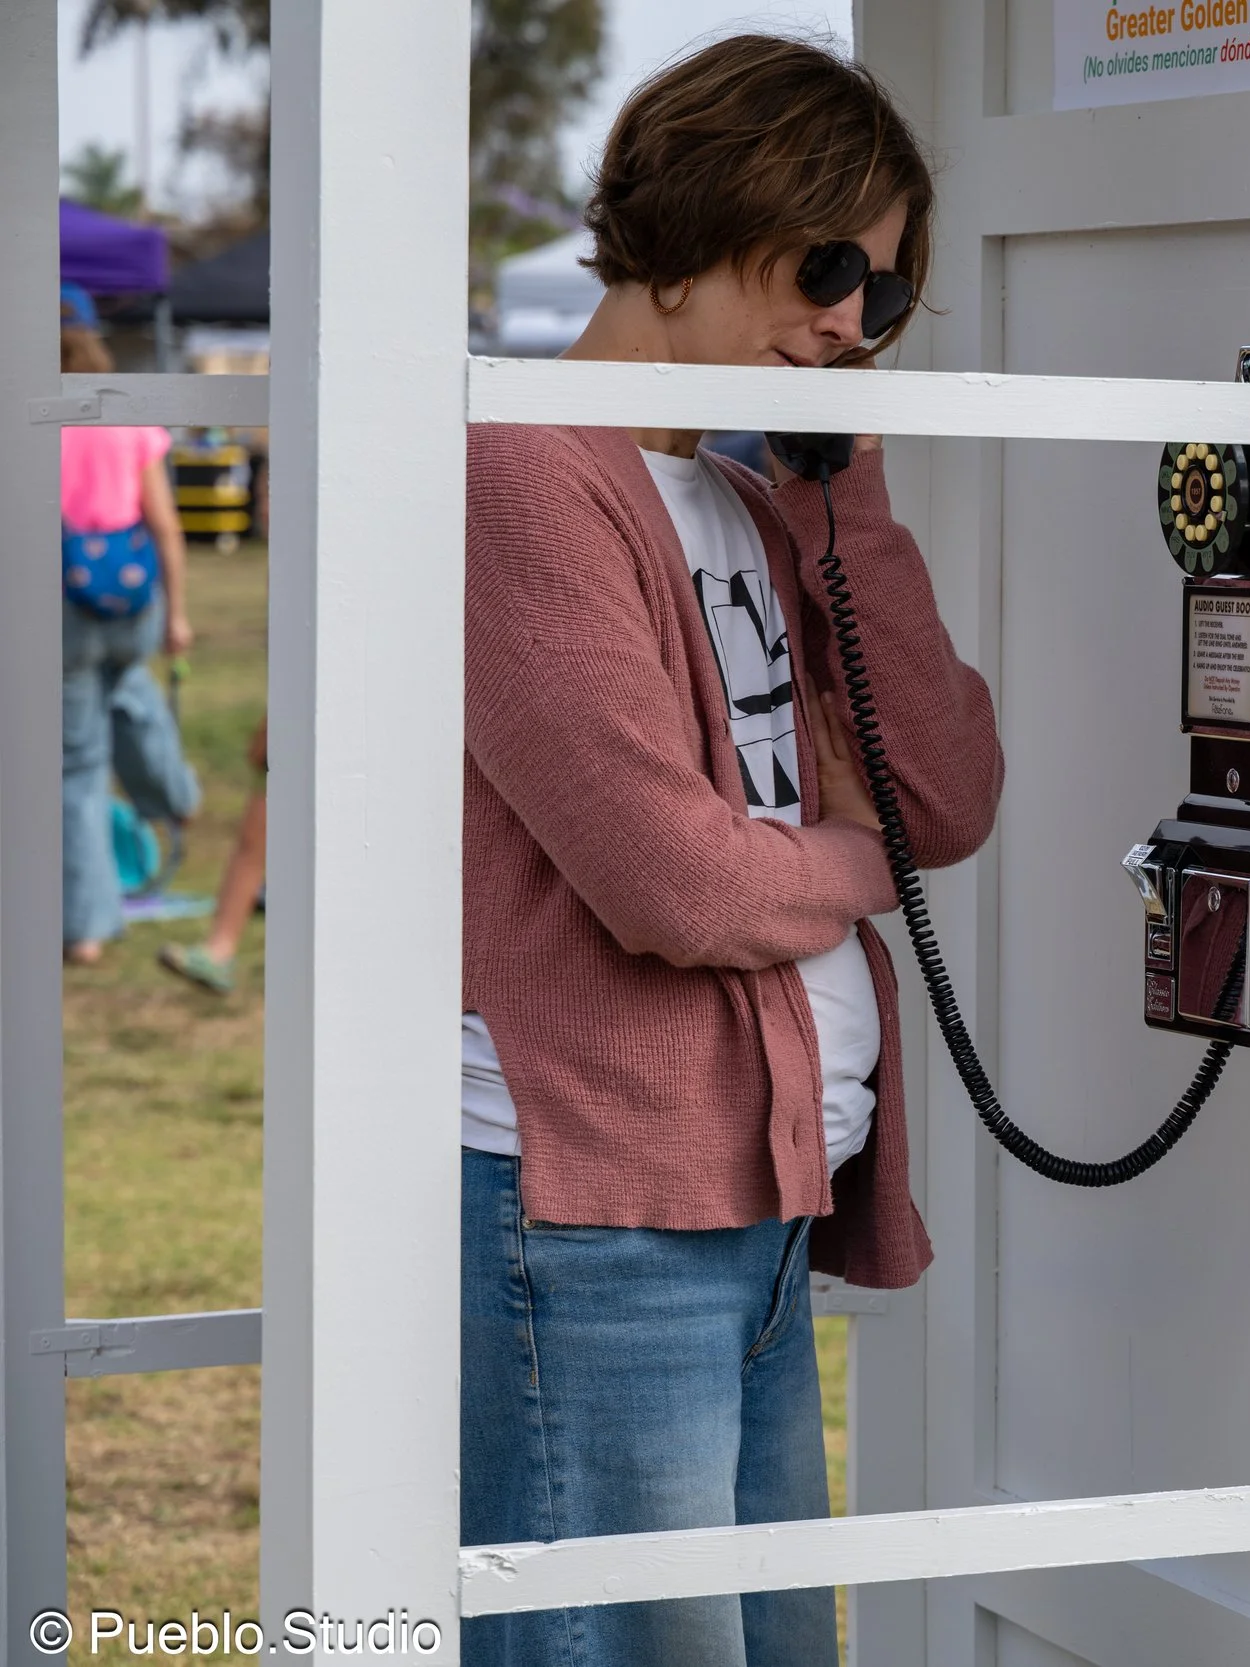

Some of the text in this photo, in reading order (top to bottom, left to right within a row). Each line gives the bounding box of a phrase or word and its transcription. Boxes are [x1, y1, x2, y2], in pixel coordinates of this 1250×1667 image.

[1106, 6, 1175, 41] Greater
[1180, 0, 1248, 31] Golden
[1083, 55, 1104, 84] (No
[1107, 50, 1149, 76] olvides
[1152, 44, 1218, 70] mencionar
[1194, 599, 1214, 612] AUDIO
[1215, 600, 1234, 613] GUEST
